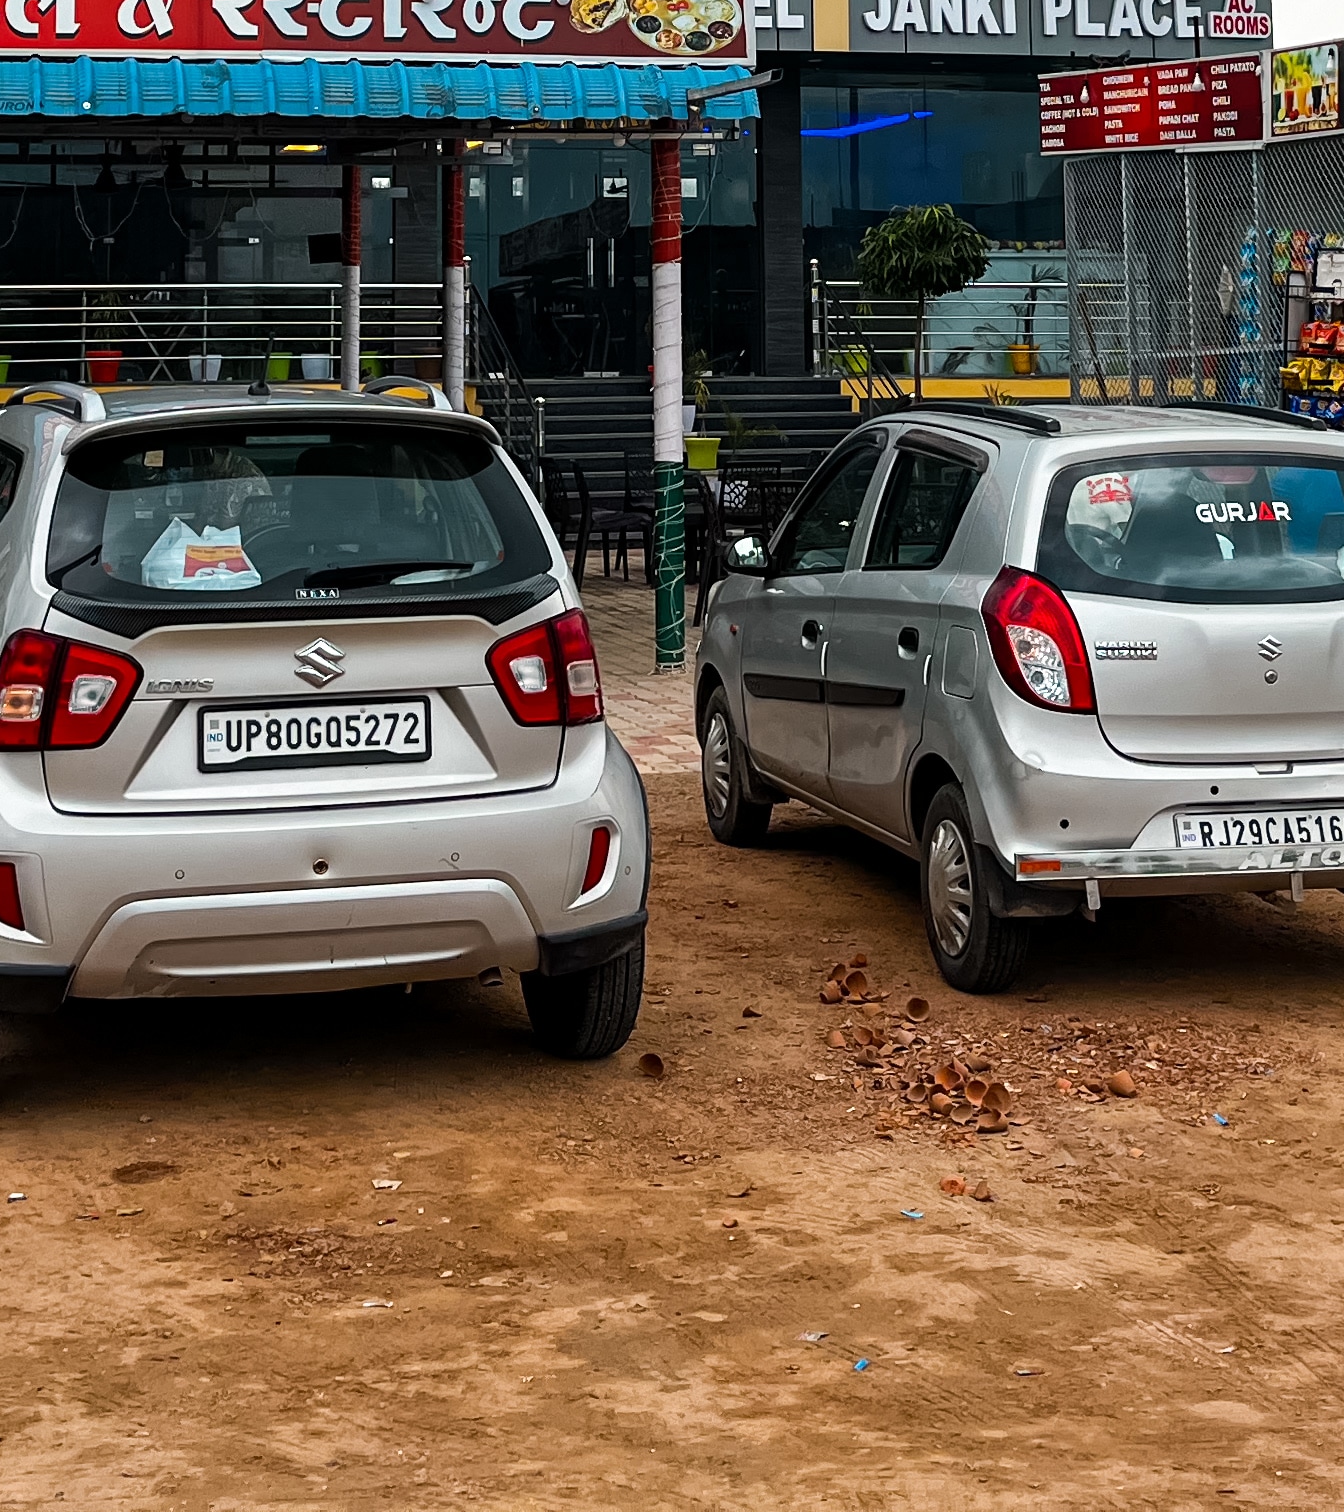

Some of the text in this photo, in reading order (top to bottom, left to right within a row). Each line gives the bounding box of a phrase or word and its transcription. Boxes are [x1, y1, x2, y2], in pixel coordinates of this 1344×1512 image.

[1212, 14, 1270, 37] ROOMS
[1041, 110, 1061, 120] COFFEE
[1214, 127, 1236, 138] PASTA
[1196, 500, 1293, 523] GURJAR
[298, 589, 338, 599] NEXA
[146, 678, 215, 694] IGNIS
[225, 712, 420, 752] UP80GQ5272
